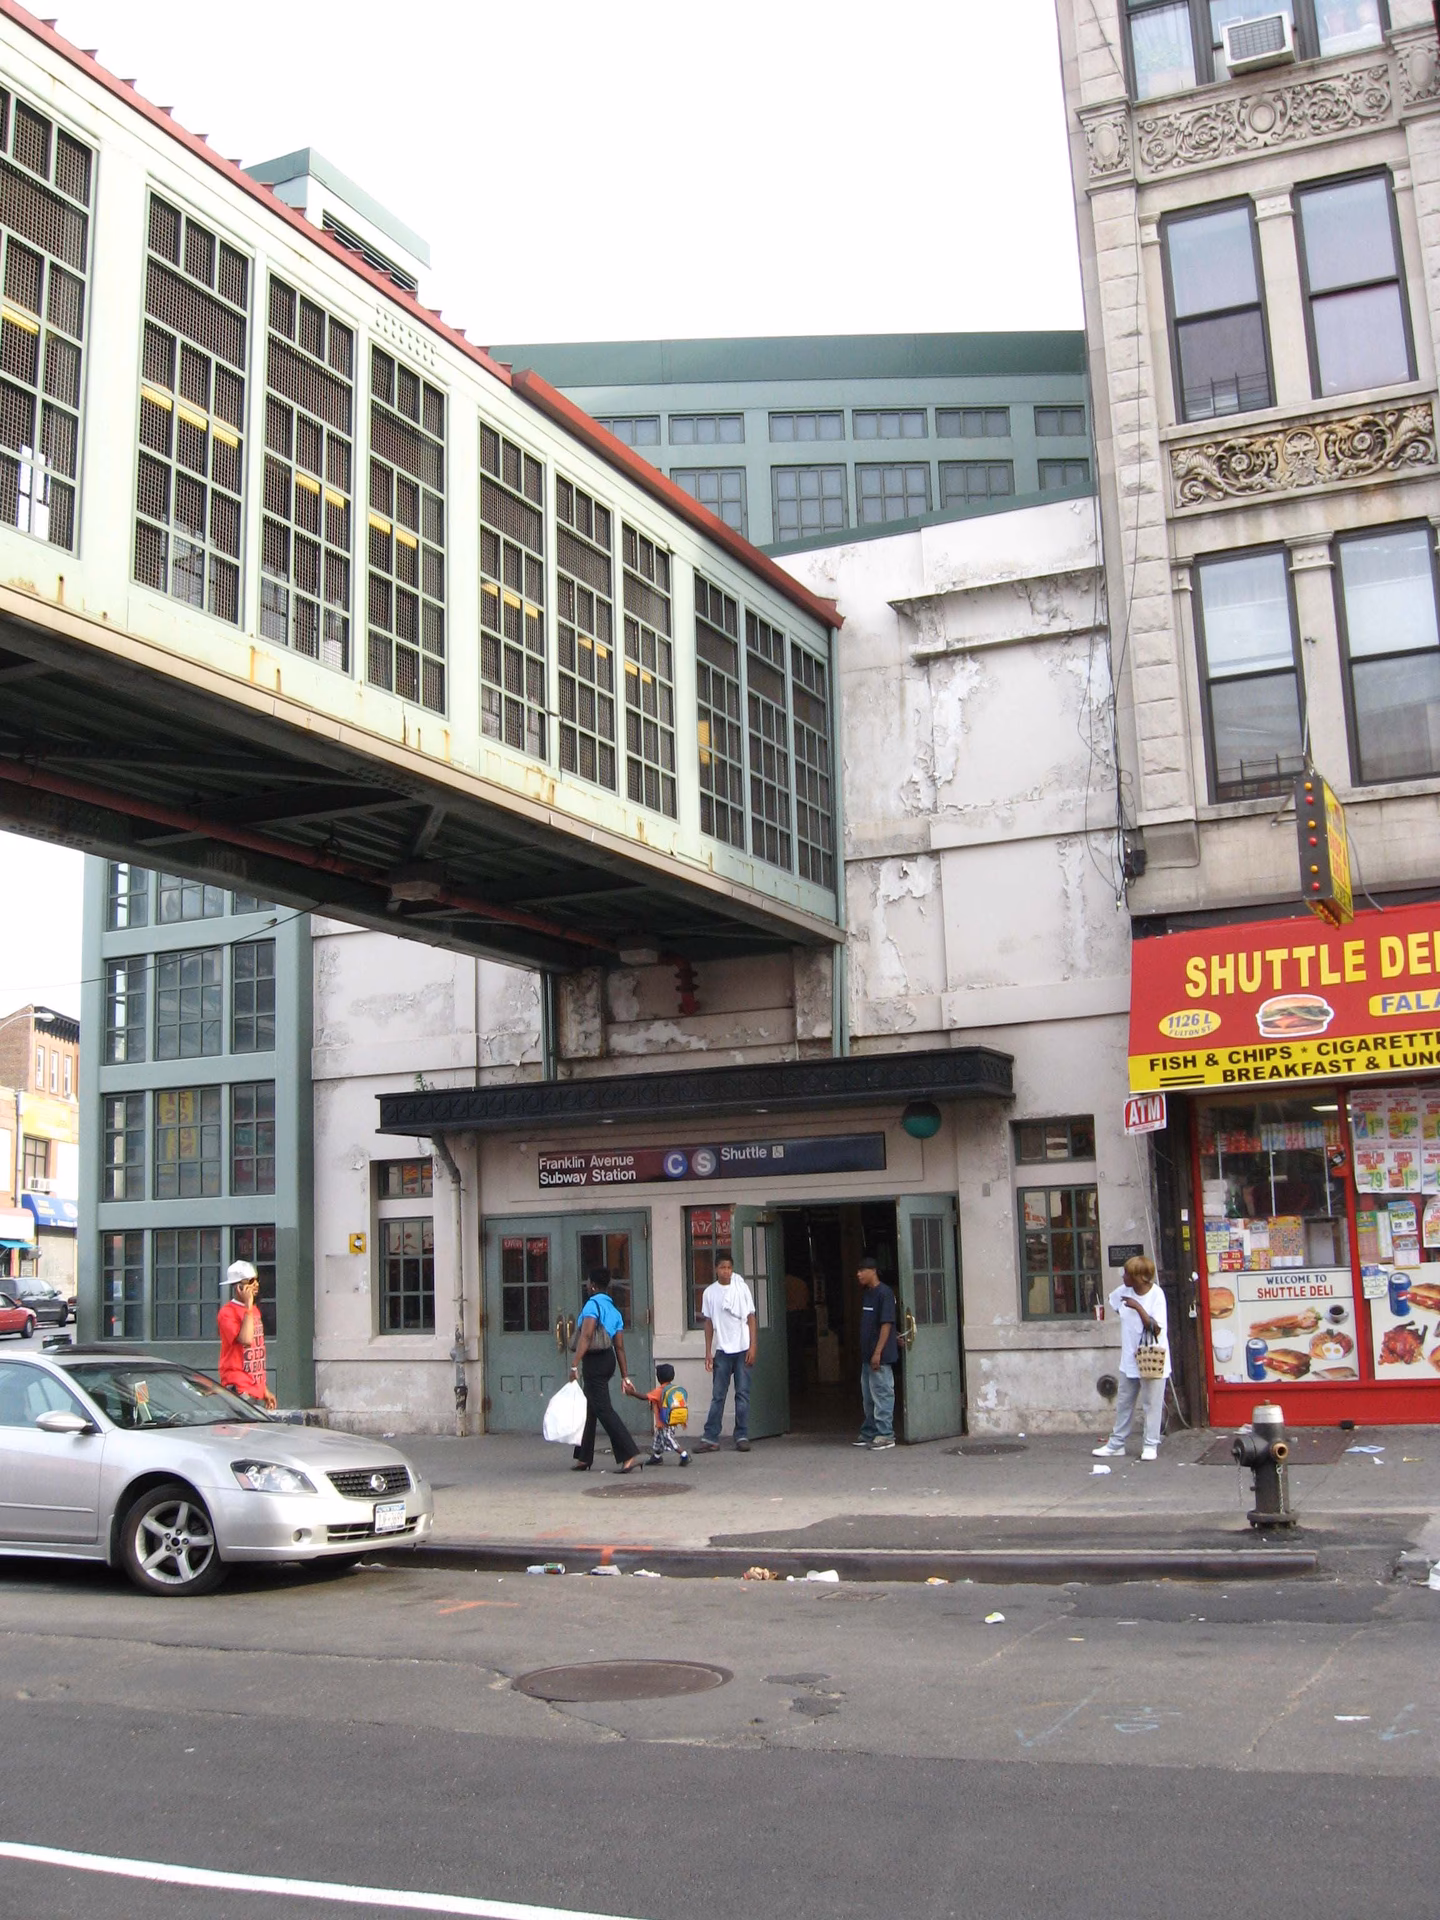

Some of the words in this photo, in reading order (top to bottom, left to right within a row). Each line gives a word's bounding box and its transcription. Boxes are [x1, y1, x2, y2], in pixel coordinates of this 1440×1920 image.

[1185, 940, 1366, 998] SHUTTLE
[1168, 1013, 1200, 1029] 1126
[1169, 1028, 1199, 1037] FULTON
[1149, 1055, 1197, 1072] FISH
[1205, 1053, 1219, 1067] &
[1228, 1046, 1293, 1065] CHIPS
[1317, 1031, 1440, 1056] CIGARETT
[1222, 1058, 1356, 1083] BREAKFAST
[1365, 1056, 1381, 1070] &
[1389, 1050, 1440, 1068] LUN
[1128, 1095, 1161, 1125] ATM
[540, 1156, 585, 1170] Franklin
[590, 1155, 634, 1168] Avenue
[668, 1154, 683, 1174] C
[697, 1153, 711, 1172] S
[721, 1146, 767, 1160] Shuttle
[540, 1171, 587, 1185] Subway
[592, 1169, 636, 1182] Station
[1266, 1275, 1310, 1285] WELCOME
[1314, 1274, 1327, 1283] TO
[1257, 1286, 1306, 1298] SHUTTLE
[1310, 1285, 1333, 1297] DELI
[244, 1348, 265, 1361] GED
